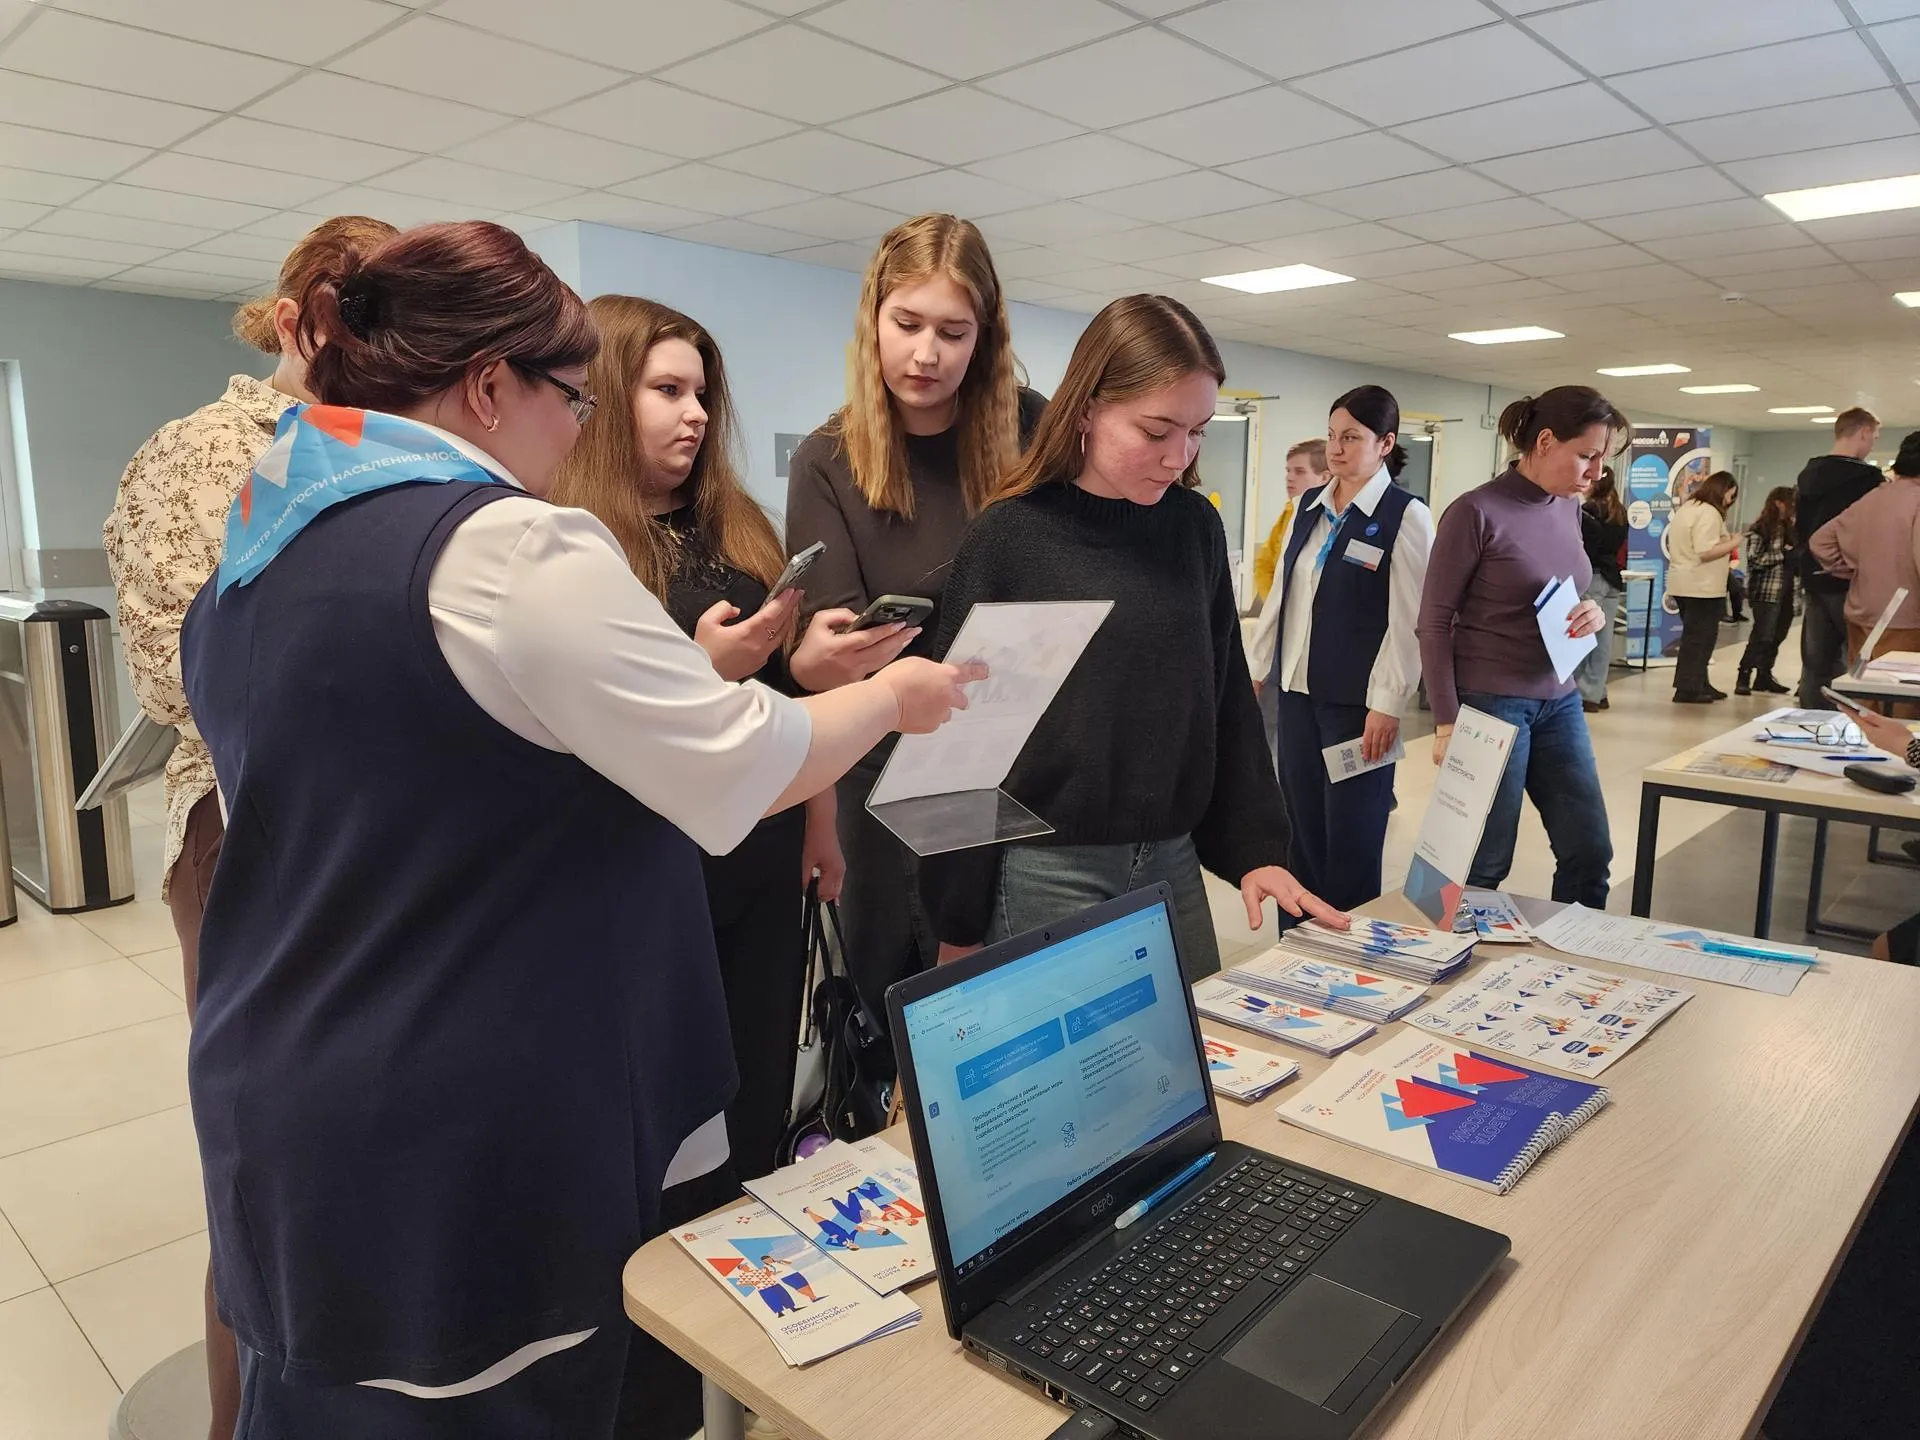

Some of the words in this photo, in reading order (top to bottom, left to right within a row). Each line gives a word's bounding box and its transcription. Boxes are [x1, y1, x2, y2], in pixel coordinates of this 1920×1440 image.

[273, 479, 330, 533] ЗАНЯТОСТИ
[332, 453, 422, 485] НАСЕЛЕНИЯ
[1449, 1102, 1497, 1143] РОССИИ
[1472, 1107, 1517, 1145] РАБОТА
[781, 1305, 839, 1332] ОСОБЕННОСТИ
[784, 1302, 860, 1337] ТРУДОУСТРОЙСТВА
[1081, 1418, 1095, 1429] ZTE
